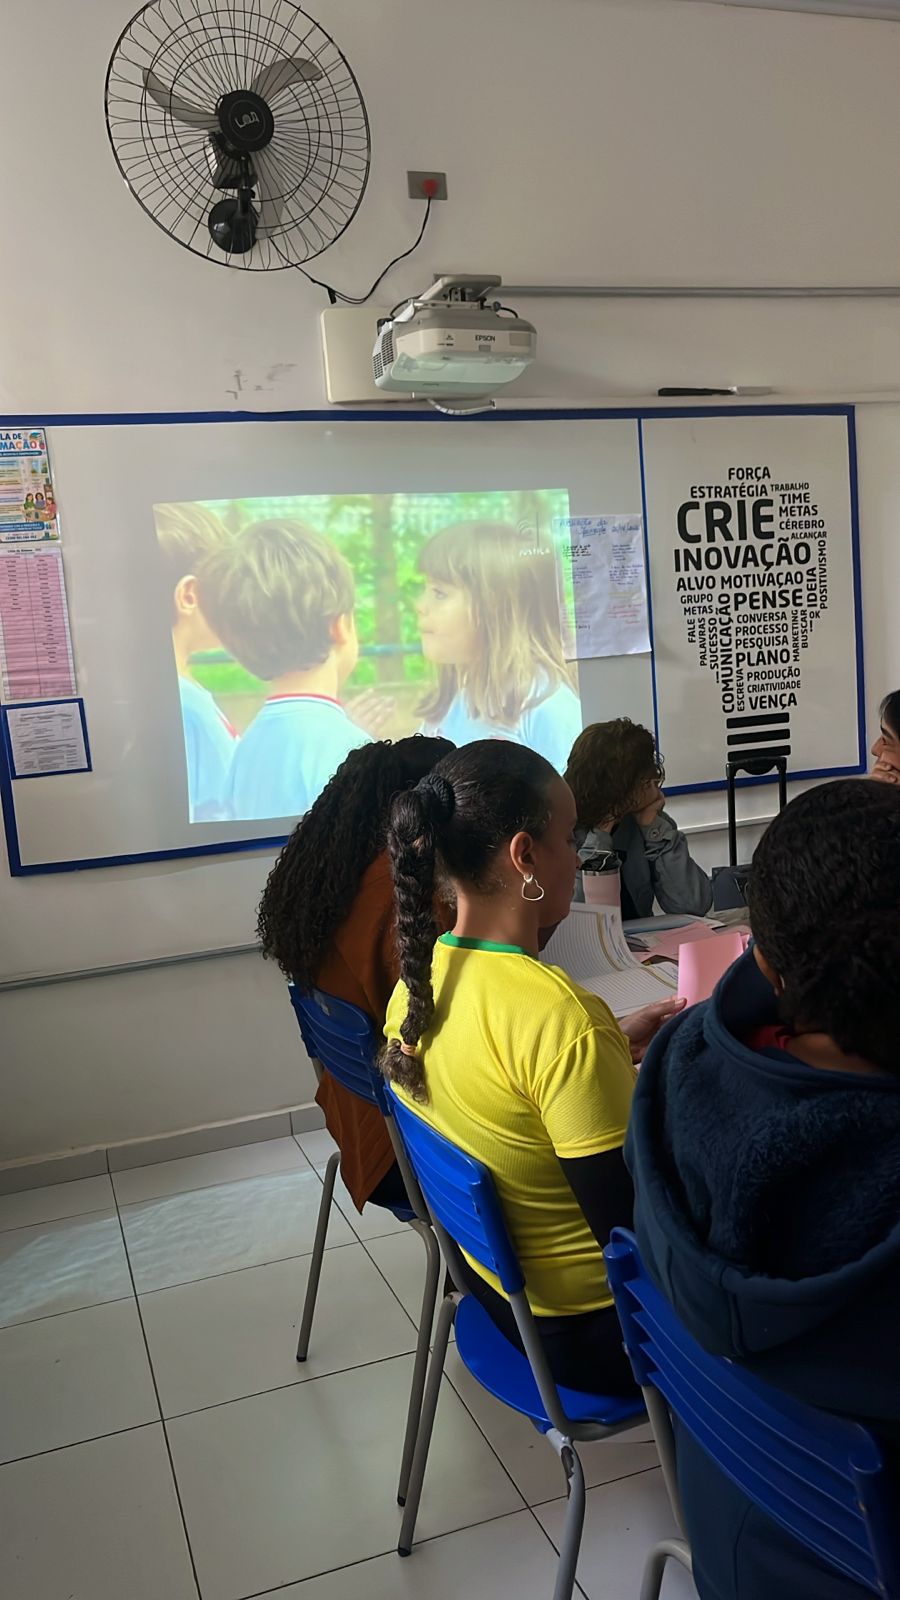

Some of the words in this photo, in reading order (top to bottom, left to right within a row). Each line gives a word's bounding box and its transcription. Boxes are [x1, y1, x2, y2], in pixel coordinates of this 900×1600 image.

[475, 334, 495, 342] EPSON
[728, 466, 770, 482] FORÇA
[690, 483, 768, 498] ESTRATÉGIA
[770, 482, 809, 492] TRABALHO
[780, 492, 810, 504] TIME
[779, 505, 818, 518] METAS
[677, 498, 775, 544] CRIE
[779, 519, 824, 530] CÉREBRO
[790, 531, 827, 540] ALCANÇAR
[674, 537, 811, 572] INOVAÇÃO
[818, 540, 828, 609] POSITIVISMO
[676, 576, 716, 592] ALVO
[806, 567, 817, 608] IDEIA
[680, 594, 713, 604] GRUPO
[734, 588, 803, 611] PENSE
[684, 605, 714, 616] METAS
[736, 612, 787, 624] CONVERSA
[810, 610, 820, 619] OK
[687, 618, 696, 643] FALE
[736, 623, 788, 636] PROCESSO
[792, 610, 800, 662] MARKETING
[800, 610, 808, 648] BUSCAR
[698, 618, 708, 666] PALAVRAS
[708, 618, 718, 670] SUCESSO
[736, 635, 788, 650] PESQUISA
[716, 593, 734, 713] COMUNICAÇÃO
[736, 648, 790, 668] PLANO
[747, 666, 800, 681] PRODUÇÃO
[736, 668, 744, 712] ESCREVA
[747, 680, 801, 694] CRIATIVIDADE
[748, 692, 798, 710] VENÇA
